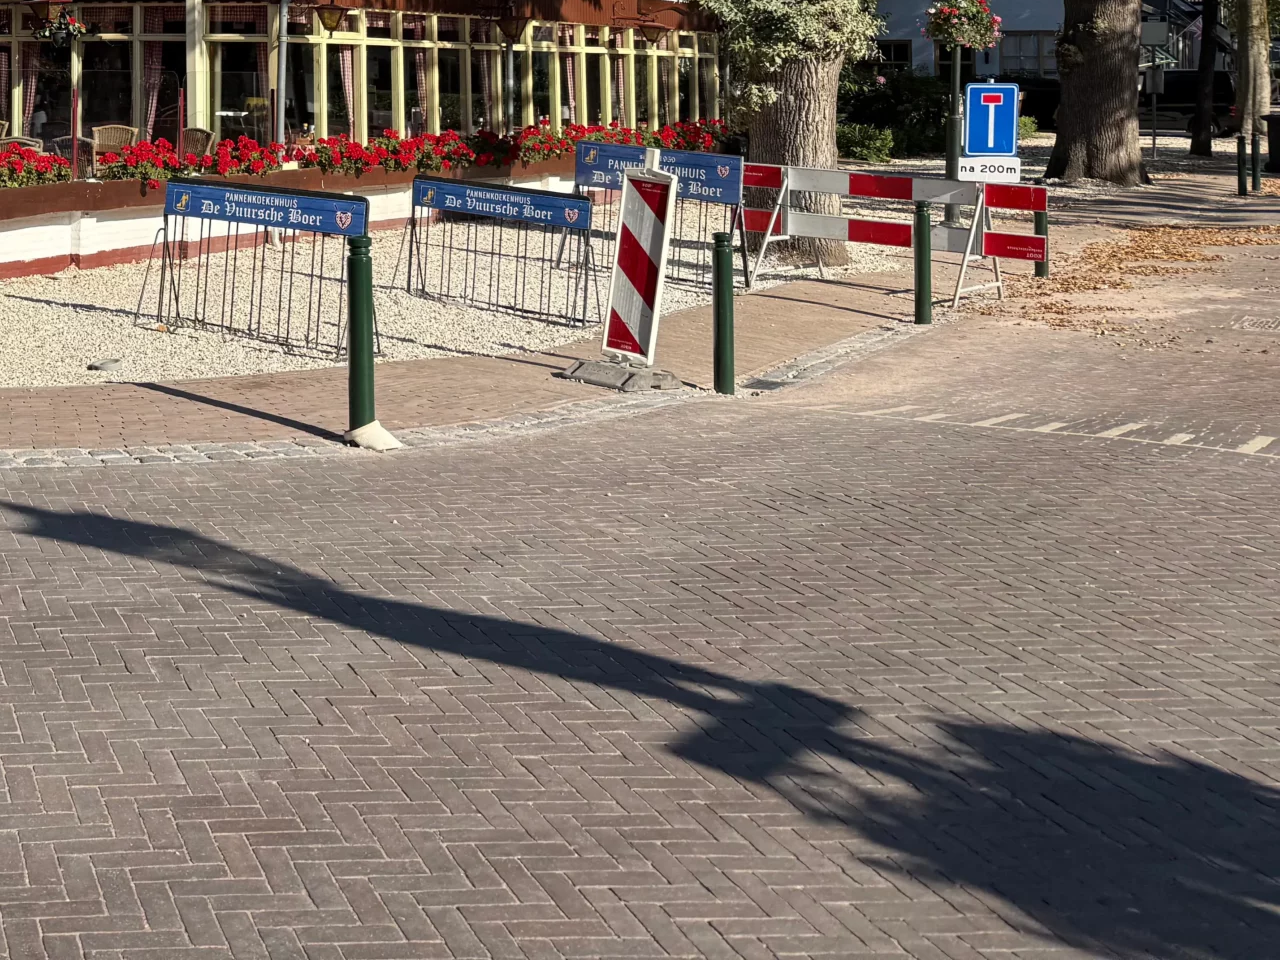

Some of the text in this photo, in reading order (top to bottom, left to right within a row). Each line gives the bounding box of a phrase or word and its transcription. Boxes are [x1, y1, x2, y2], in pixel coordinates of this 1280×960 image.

[591, 170, 612, 184] De
[960, 165, 975, 173] na
[466, 189, 531, 205] PANNENKOEKENHUIS
[687, 180, 723, 197] Boer
[225, 192, 298, 209] PANNENKOEKENHUIS
[444, 195, 553, 220] De Vuursche Boer
[200, 199, 323, 226] De Vuursche Boer
